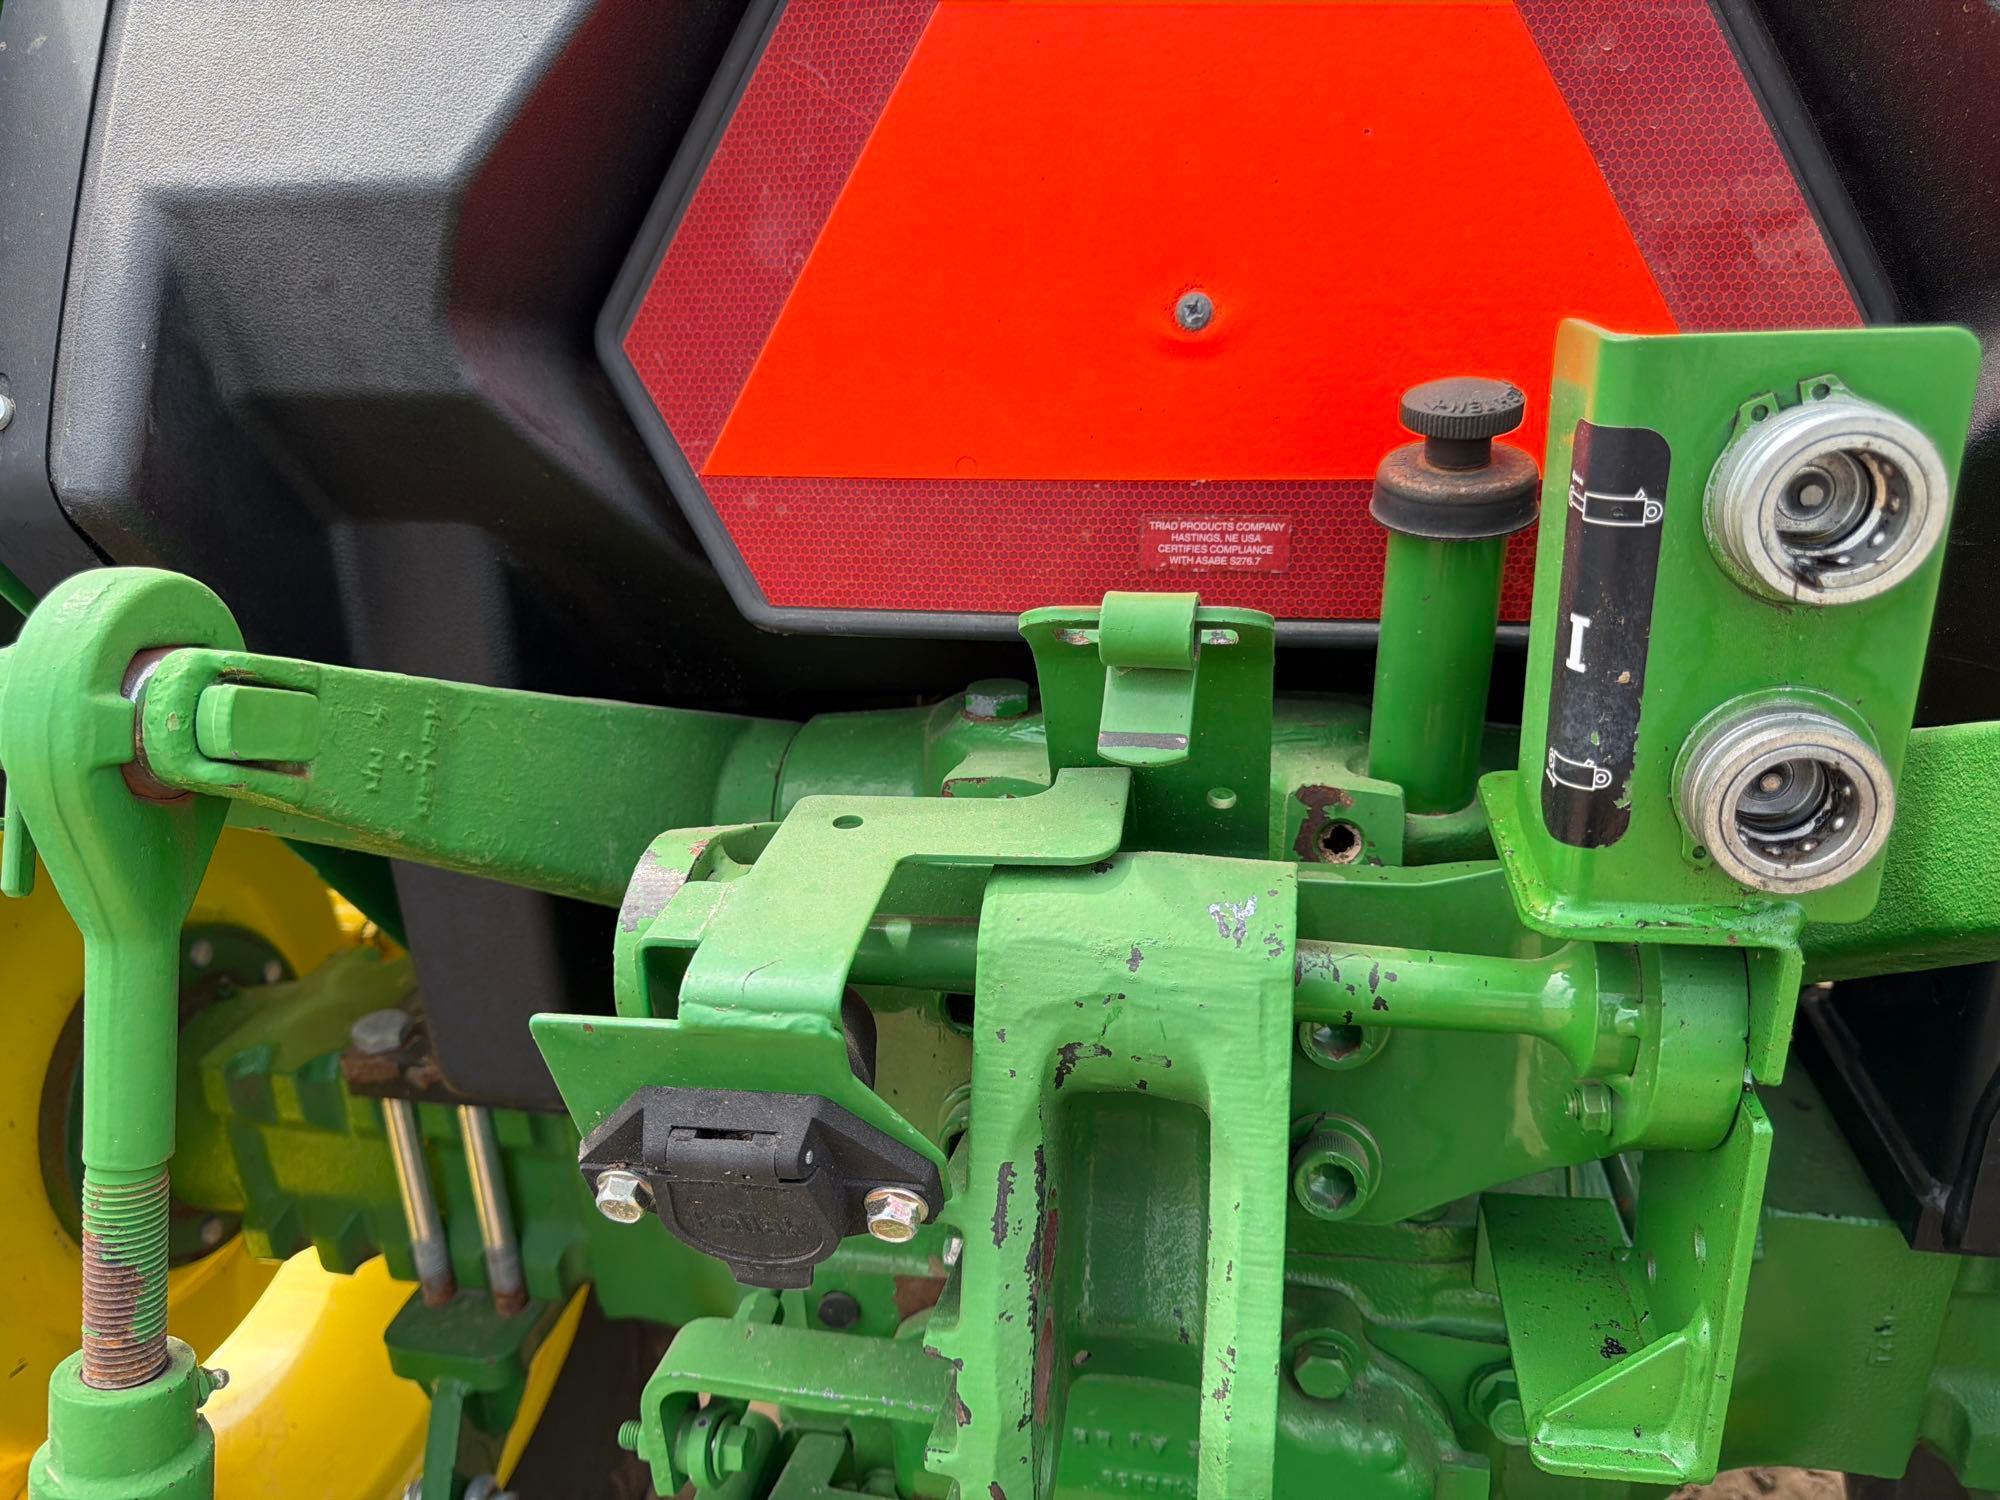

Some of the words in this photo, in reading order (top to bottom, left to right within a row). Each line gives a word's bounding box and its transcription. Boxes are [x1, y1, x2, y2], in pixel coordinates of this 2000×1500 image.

[1149, 521, 1178, 531] TRIAD
[1180, 521, 1234, 531] PRODUCTS
[1235, 522, 1286, 532] COMPANY
[1171, 533, 1222, 543] HASTINGS,
[1224, 533, 1238, 543] NE
[1240, 533, 1262, 543] USA
[1157, 544, 1208, 554] CERTIFIES
[1209, 545, 1274, 555] COMPLIANCE
[1169, 556, 1194, 565] WITH
[1195, 556, 1227, 565] ASABE
[1229, 556, 1262, 565] S276.7
